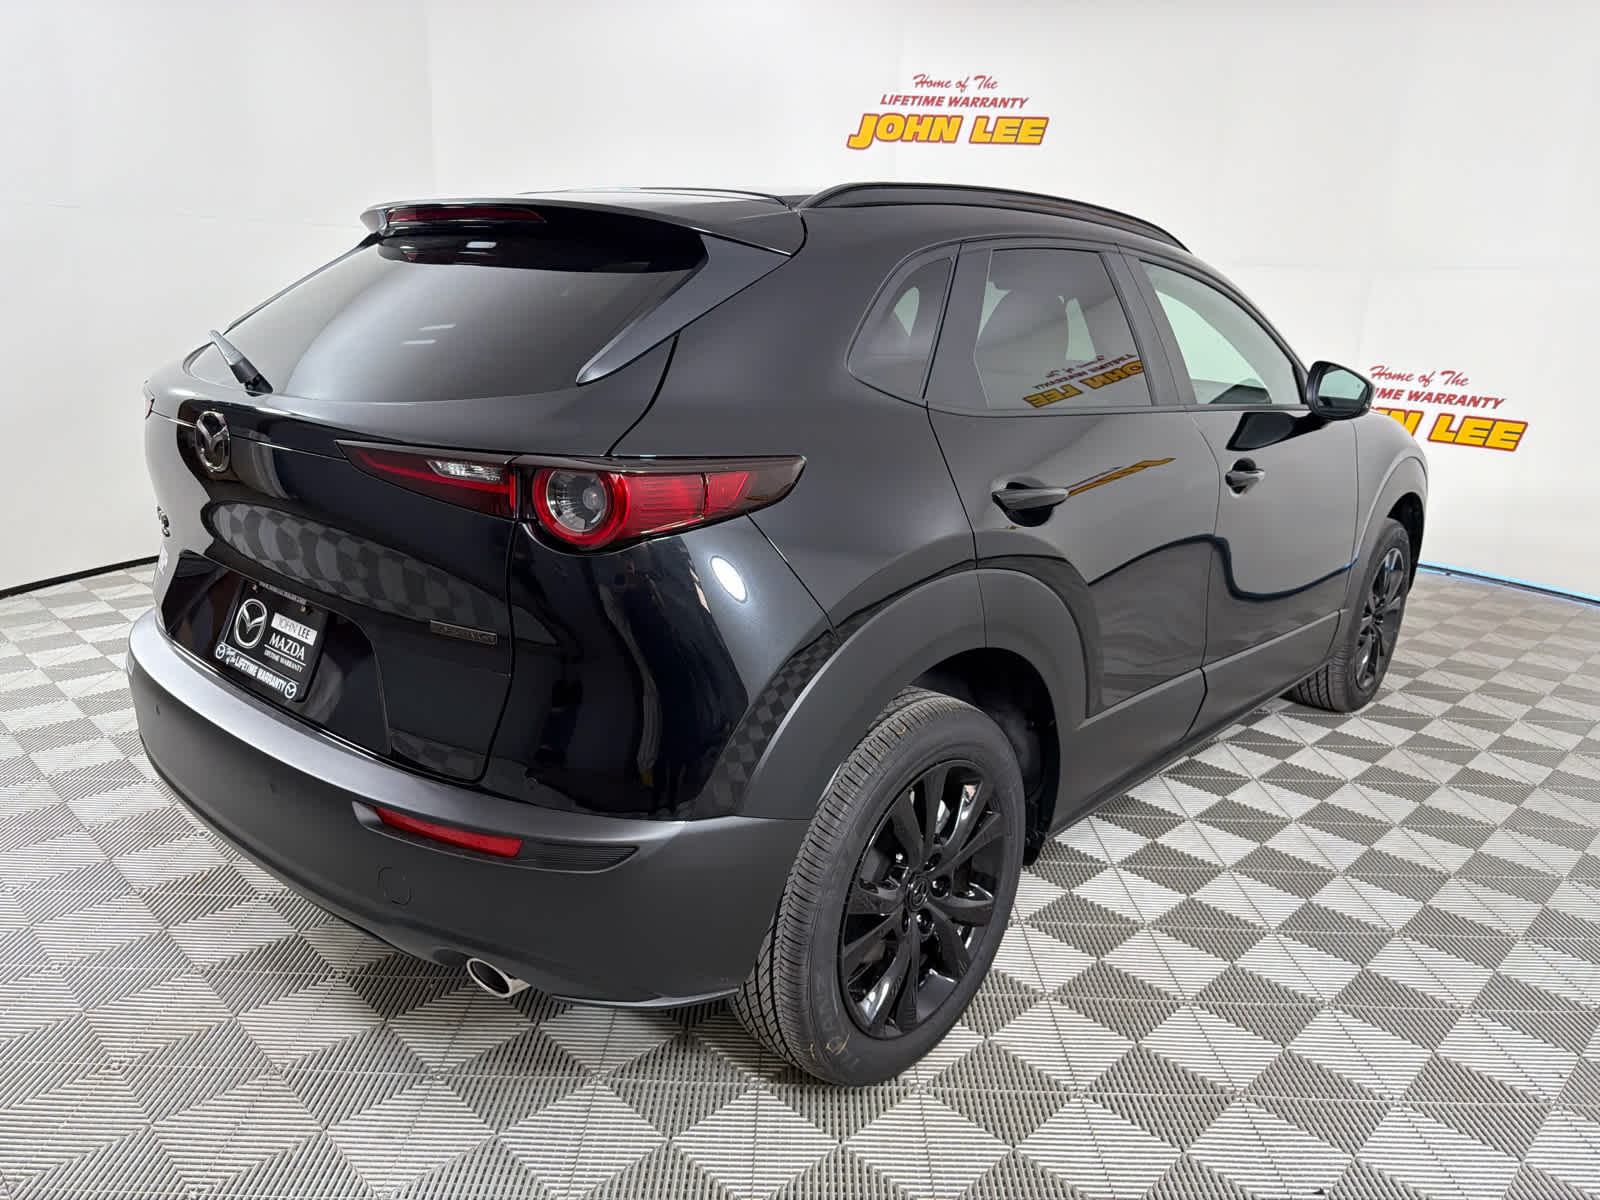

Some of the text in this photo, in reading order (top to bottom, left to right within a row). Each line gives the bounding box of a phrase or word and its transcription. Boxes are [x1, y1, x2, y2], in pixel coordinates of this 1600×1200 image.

[913, 73, 998, 93] Home of The
[880, 94, 1029, 109] LIFETIME WARRANTY
[846, 112, 1049, 150] JOHN LEE
[1369, 365, 1470, 387] Home of The
[1407, 390, 1506, 409] WARRANTY
[1427, 413, 1528, 452] LEE
[297, 626, 311, 640] LEE
[269, 632, 305, 661] MAZDA
